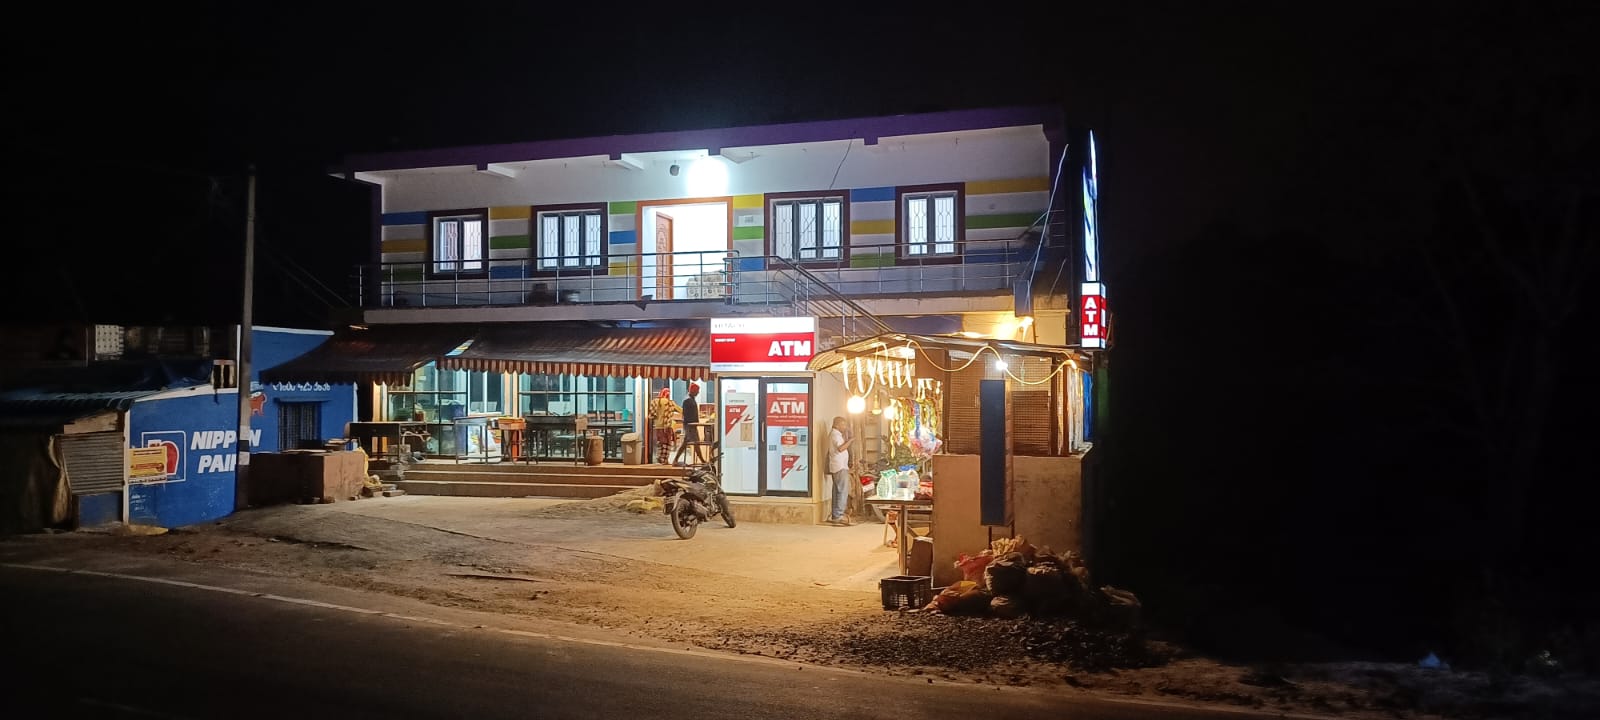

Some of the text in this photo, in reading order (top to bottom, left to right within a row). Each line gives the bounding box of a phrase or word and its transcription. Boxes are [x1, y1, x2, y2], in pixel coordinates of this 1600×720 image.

[1084, 297, 1098, 336] ATM
[768, 340, 811, 357] ATM
[770, 401, 805, 414] ATM
[190, 429, 262, 450] NIPPN
[197, 453, 237, 474] PAI
